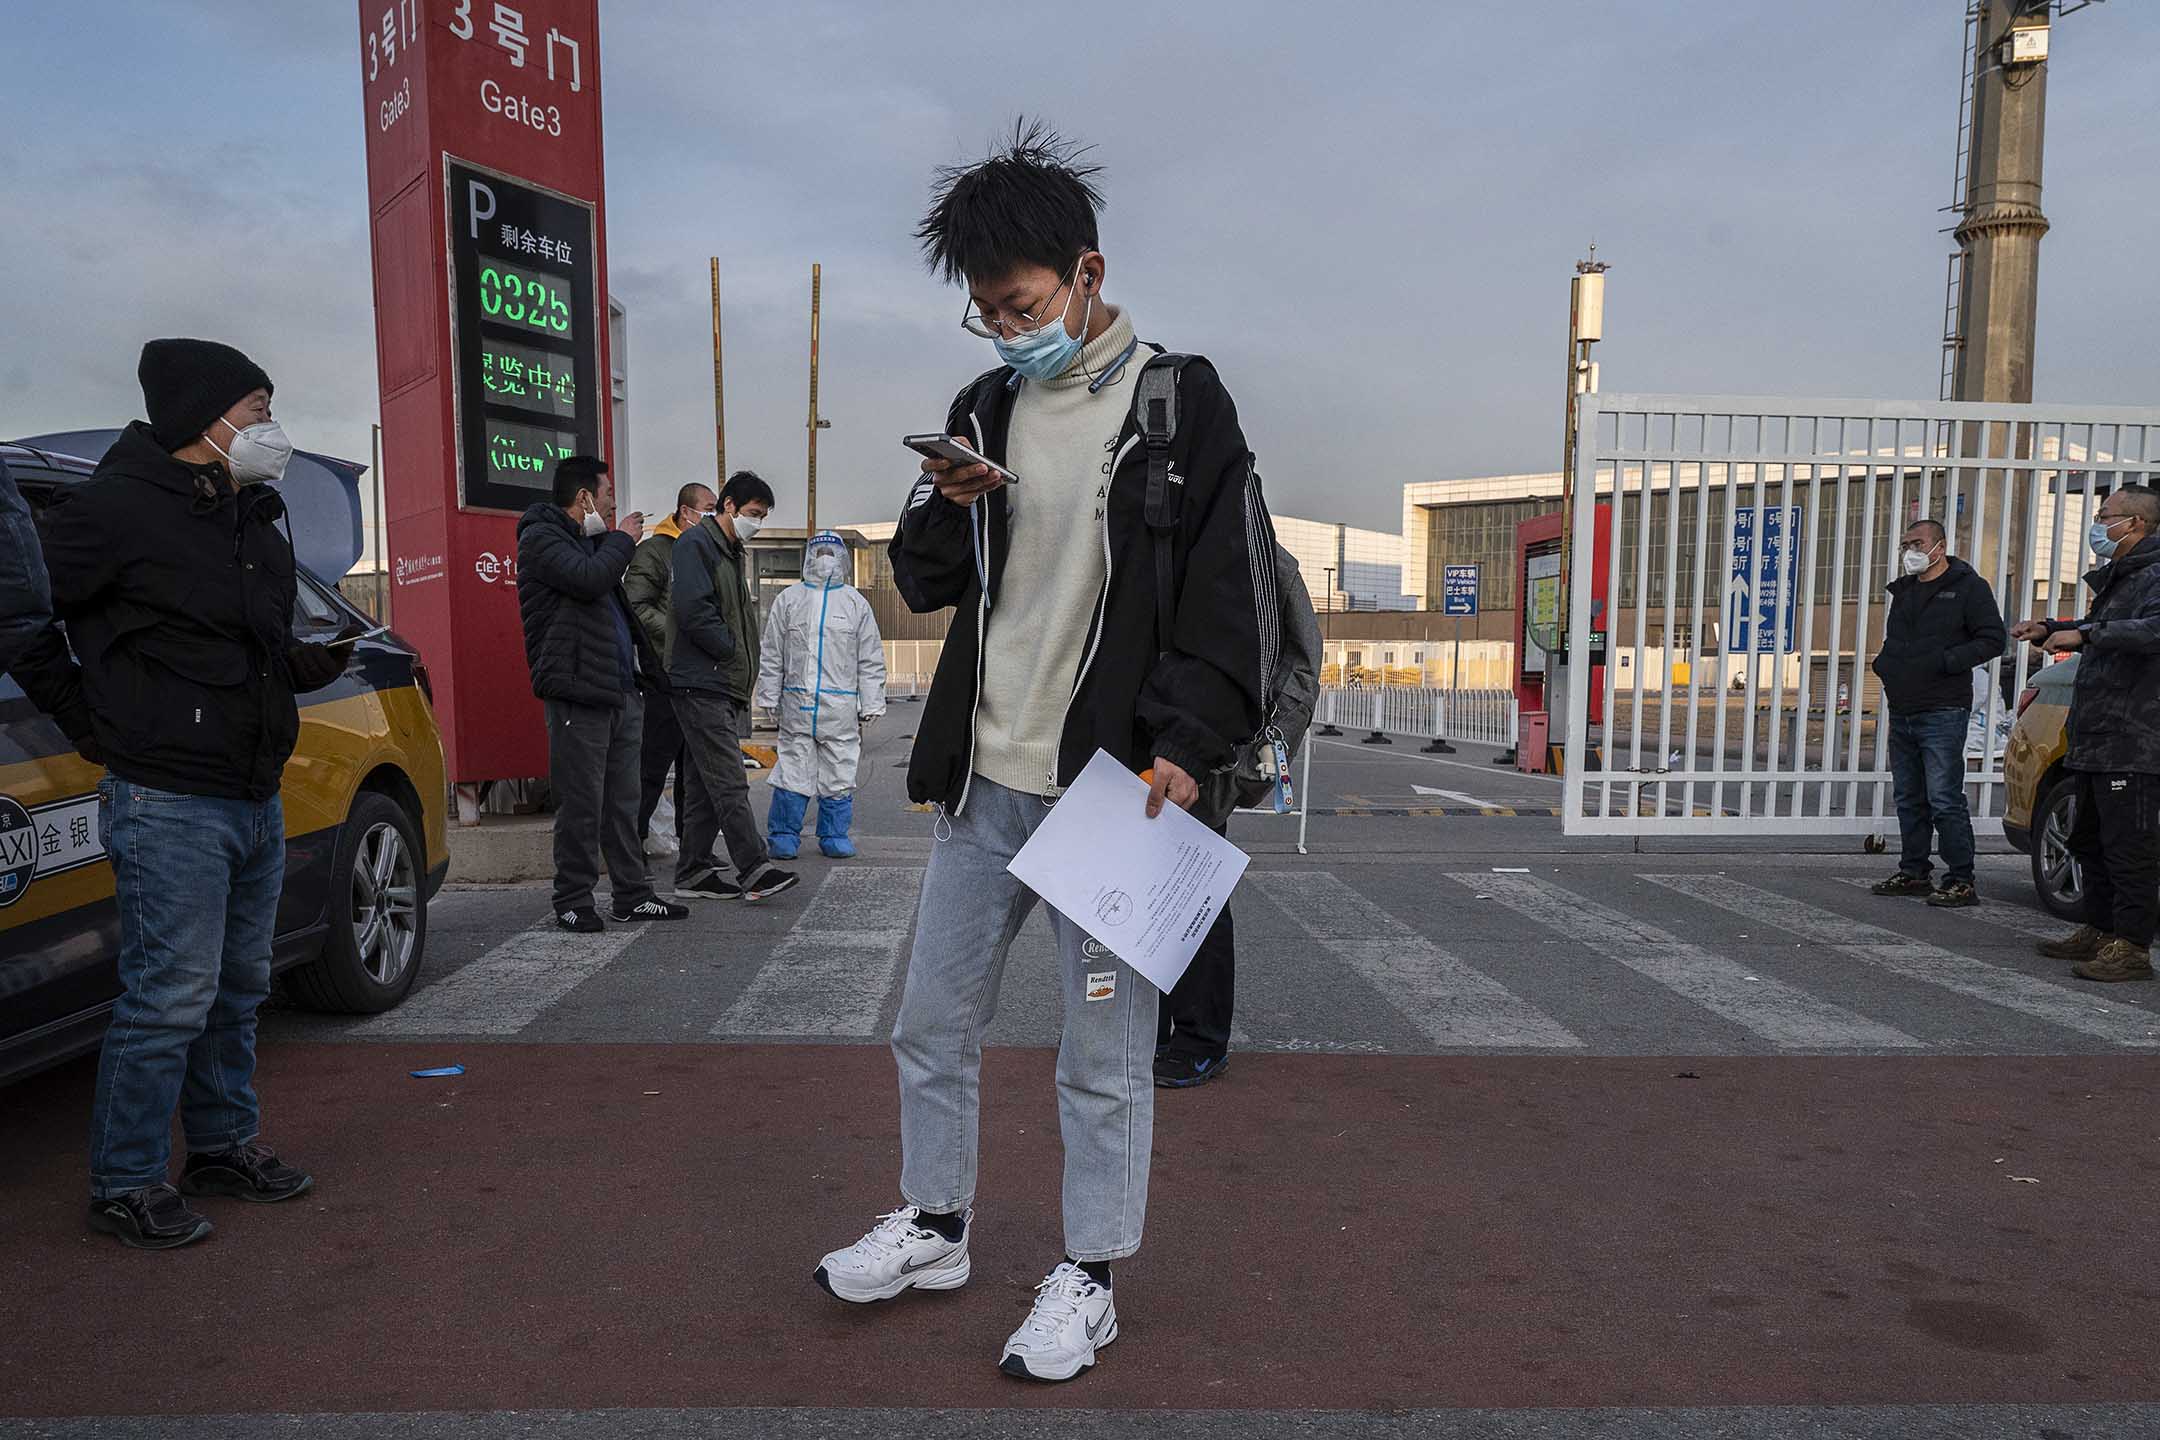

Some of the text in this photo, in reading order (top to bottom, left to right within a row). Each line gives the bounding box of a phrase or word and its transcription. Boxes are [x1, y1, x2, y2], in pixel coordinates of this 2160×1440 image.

[368, 0, 417, 82] 3号门
[448, 0, 580, 92] 3号门
[379, 76, 411, 132] Gate3
[480, 79, 561, 136] Gate3
[468, 179, 497, 239] P
[500, 224, 573, 265] 剩余车位
[480, 268, 569, 331] 0325
[475, 559, 502, 574] CIEC
[40, 815, 91, 857] 金银
